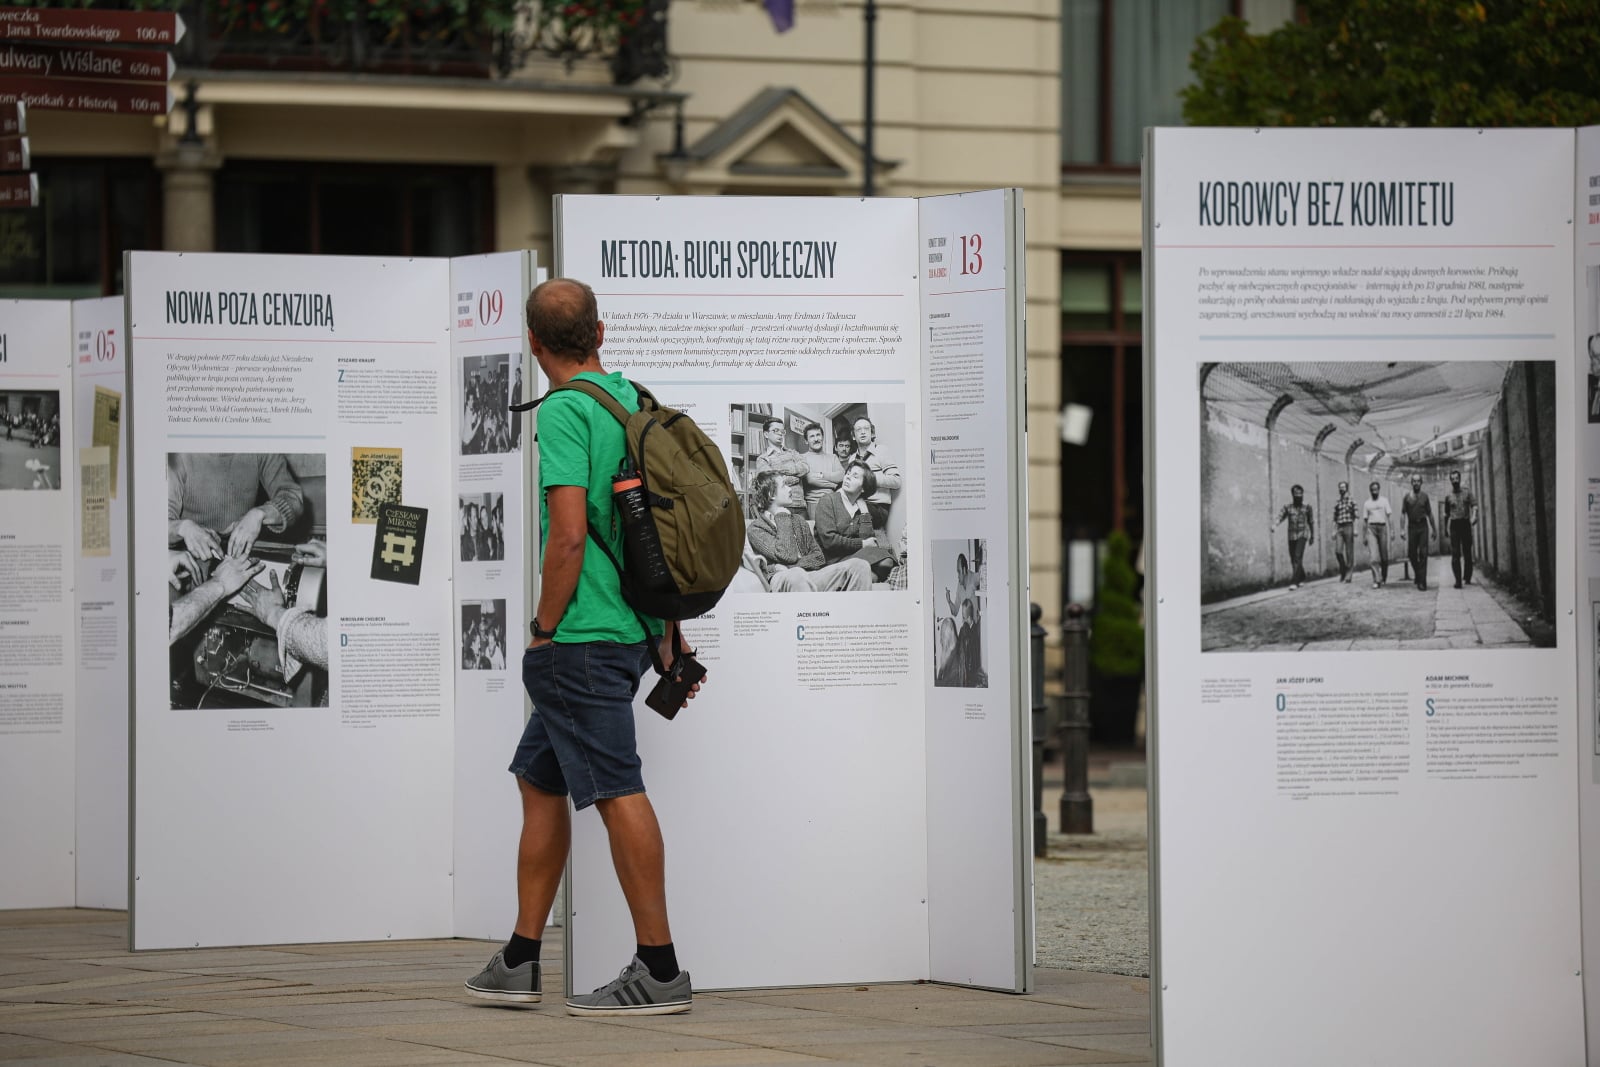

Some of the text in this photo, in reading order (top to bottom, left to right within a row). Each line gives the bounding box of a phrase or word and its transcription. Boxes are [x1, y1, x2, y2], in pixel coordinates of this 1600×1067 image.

[7, 23, 169, 42] Jana Twardowskiego 100 m
[60, 50, 122, 74] Wiślane
[130, 62, 149, 75] 650
[150, 66, 161, 76] m
[21, 92, 64, 108] Spotkań
[68, 97, 75, 108] z
[78, 96, 118, 112] Historią
[131, 98, 149, 111] 100
[150, 101, 160, 111] m
[1199, 181, 1454, 227] KOROWCY BEZ KOMITETU
[601, 240, 837, 279] METODA: RUCH SPOŁECZNY
[959, 233, 983, 276] 13
[166, 291, 334, 332] NOWA POZA CENZURĄ
[479, 289, 503, 326] 09
[611, 311, 632, 320] latach
[738, 311, 774, 320] mieszkaniu
[97, 328, 116, 362] 05
